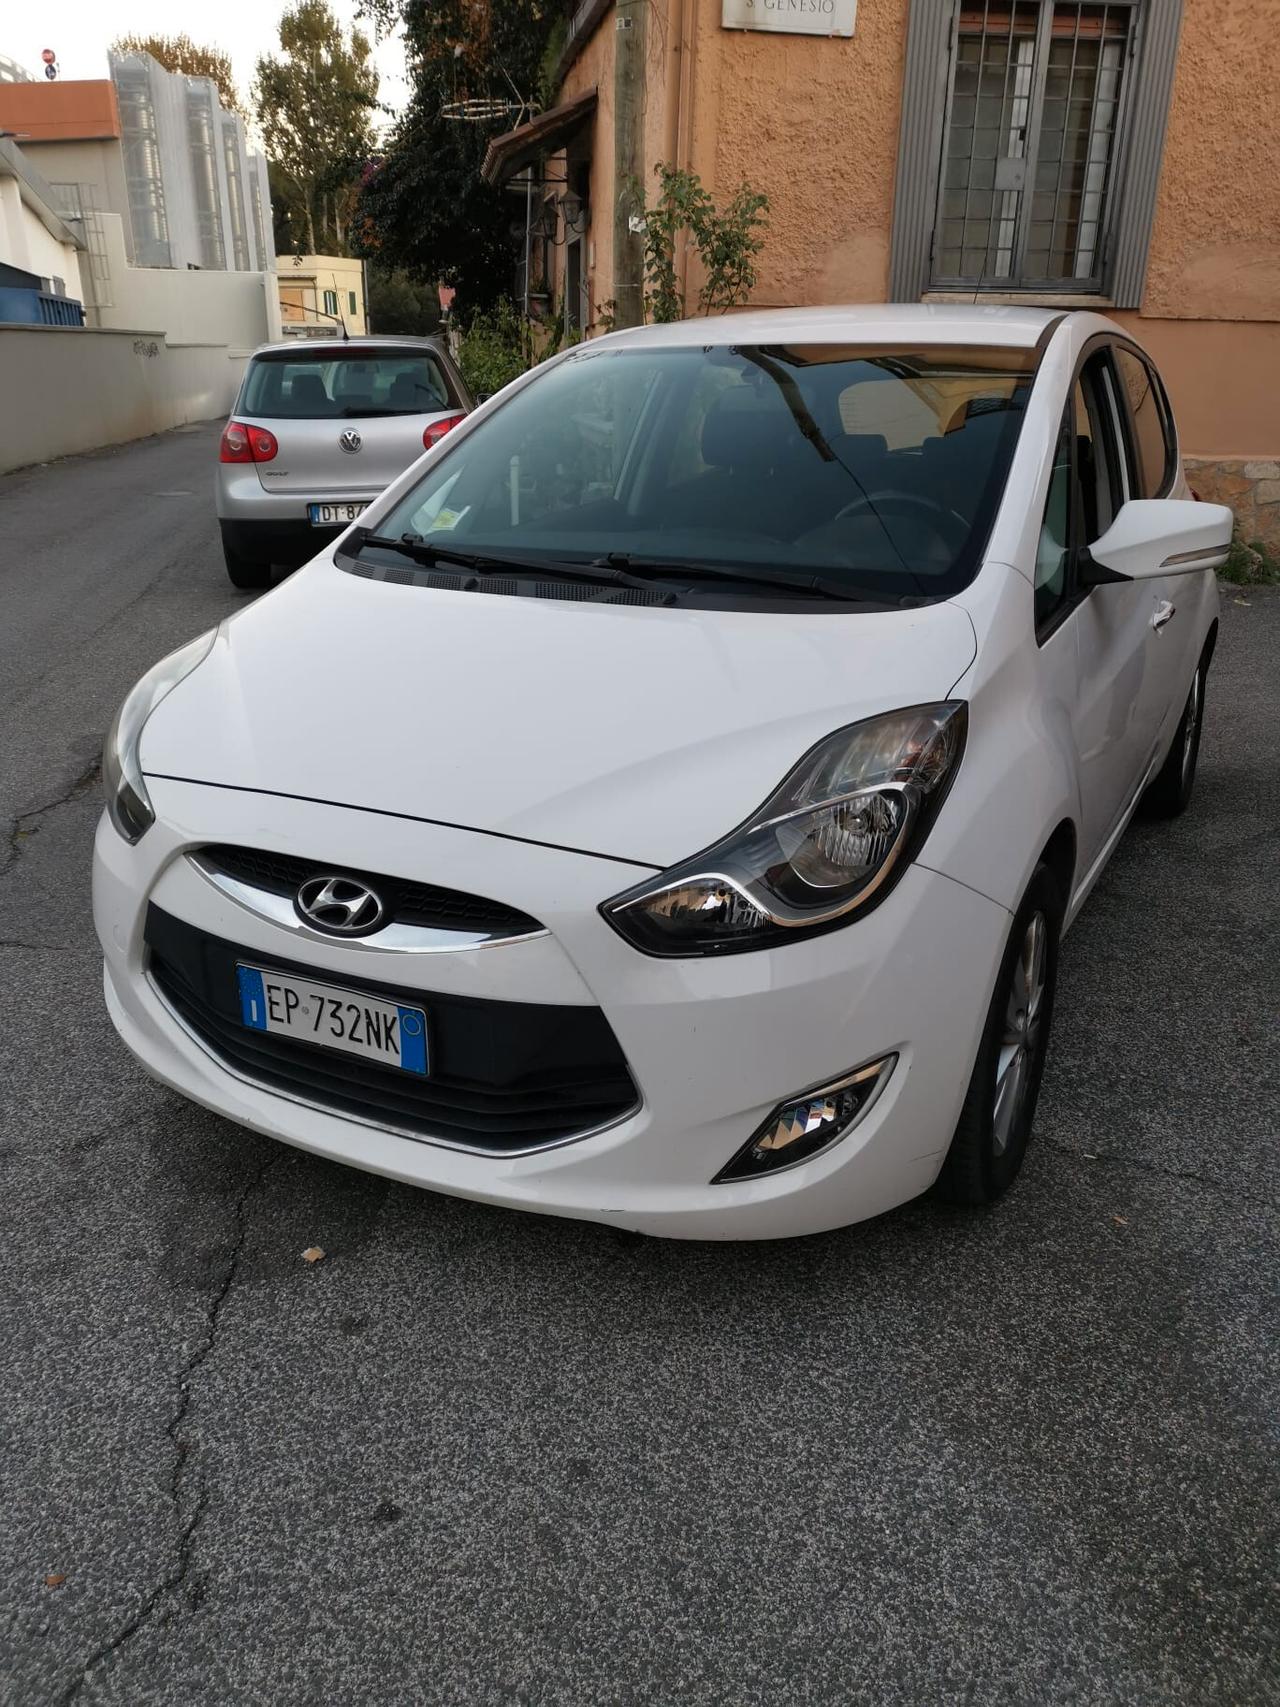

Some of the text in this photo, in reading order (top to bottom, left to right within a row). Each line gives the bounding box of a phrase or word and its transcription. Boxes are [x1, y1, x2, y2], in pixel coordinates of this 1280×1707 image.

[764, 0, 834, 13] GENESIO
[322, 506, 340, 521] DT
[267, 984, 399, 1055] EP 732NK
